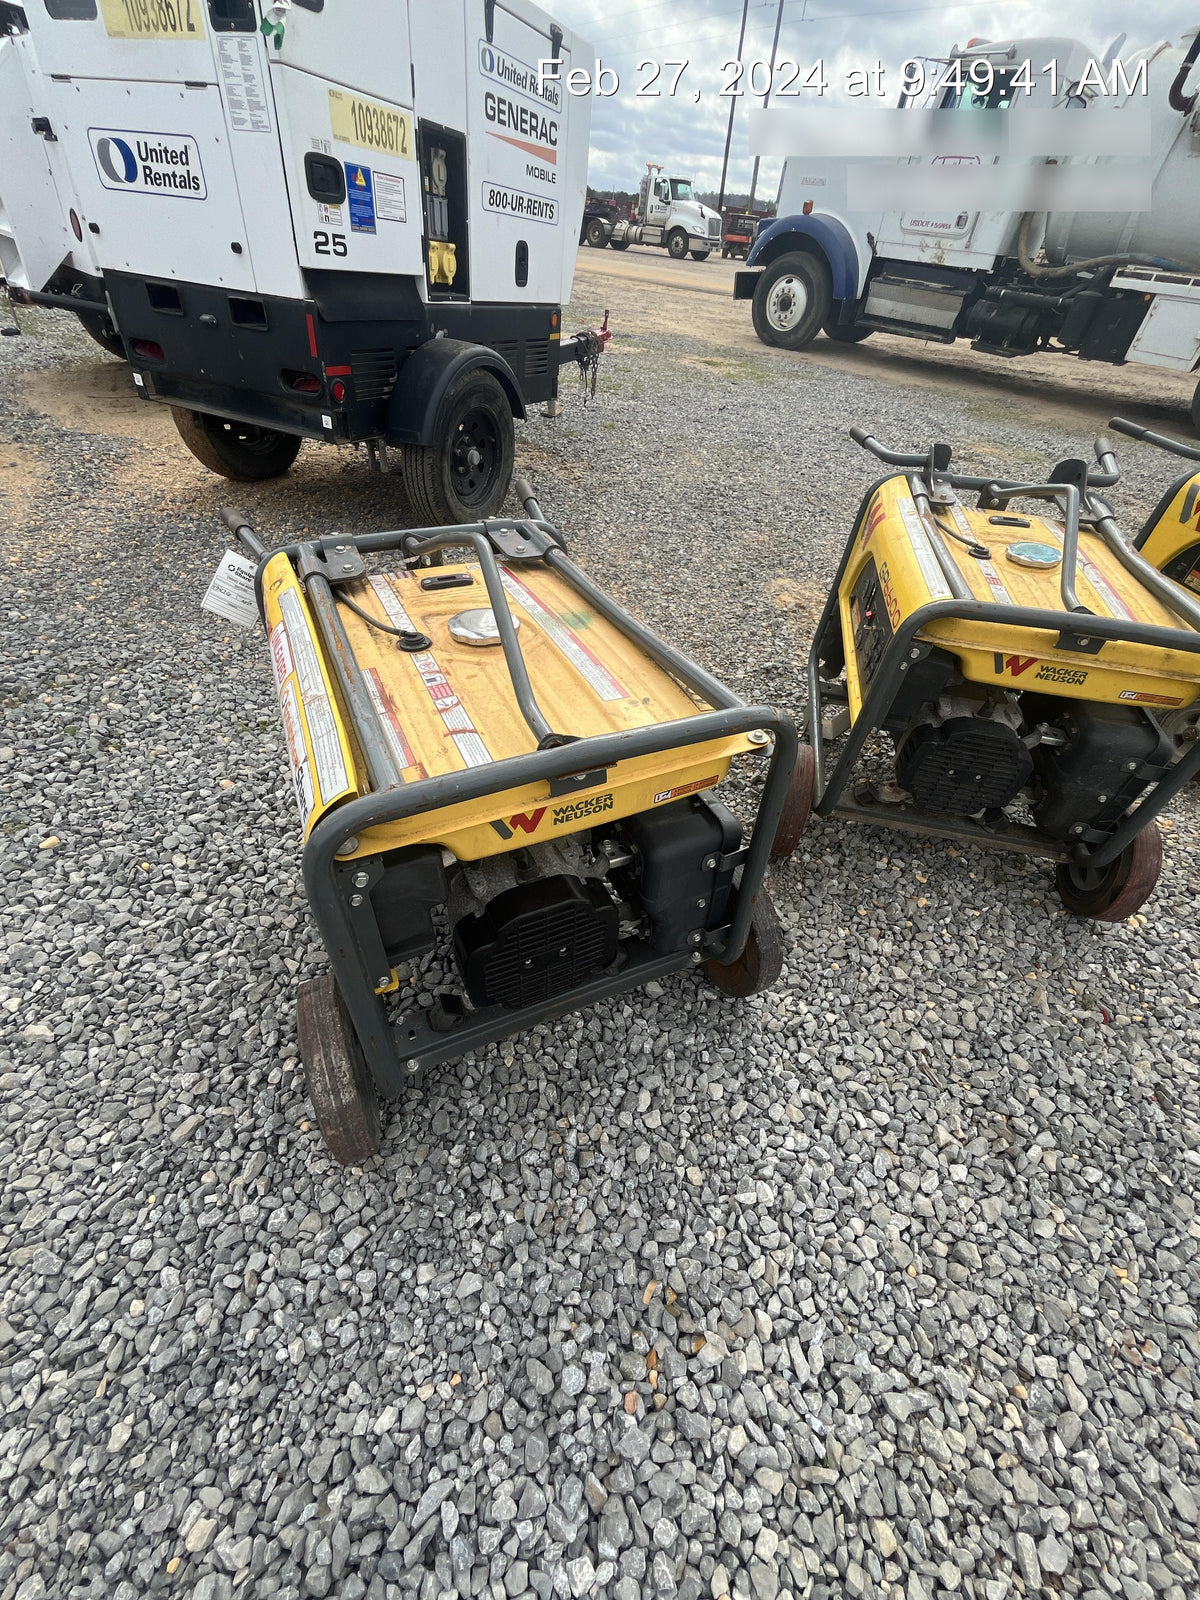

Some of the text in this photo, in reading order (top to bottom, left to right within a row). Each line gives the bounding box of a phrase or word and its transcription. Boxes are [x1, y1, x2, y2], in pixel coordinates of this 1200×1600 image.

[496, 56, 528, 90] United
[351, 100, 408, 154] 10938672
[484, 91, 558, 147] GENERAC
[136, 140, 190, 166] United
[142, 165, 200, 191] Rentals
[525, 164, 557, 184] MOBILE
[488, 188, 555, 220] 800-UR-RENTS
[313, 231, 348, 257] 25
[879, 561, 901, 629] GP6600
[1034, 672, 1086, 686] NEUSON
[1040, 665, 1089, 680] WACKER
[553, 793, 614, 817] WACKER
[553, 801, 614, 826] NEUSON
